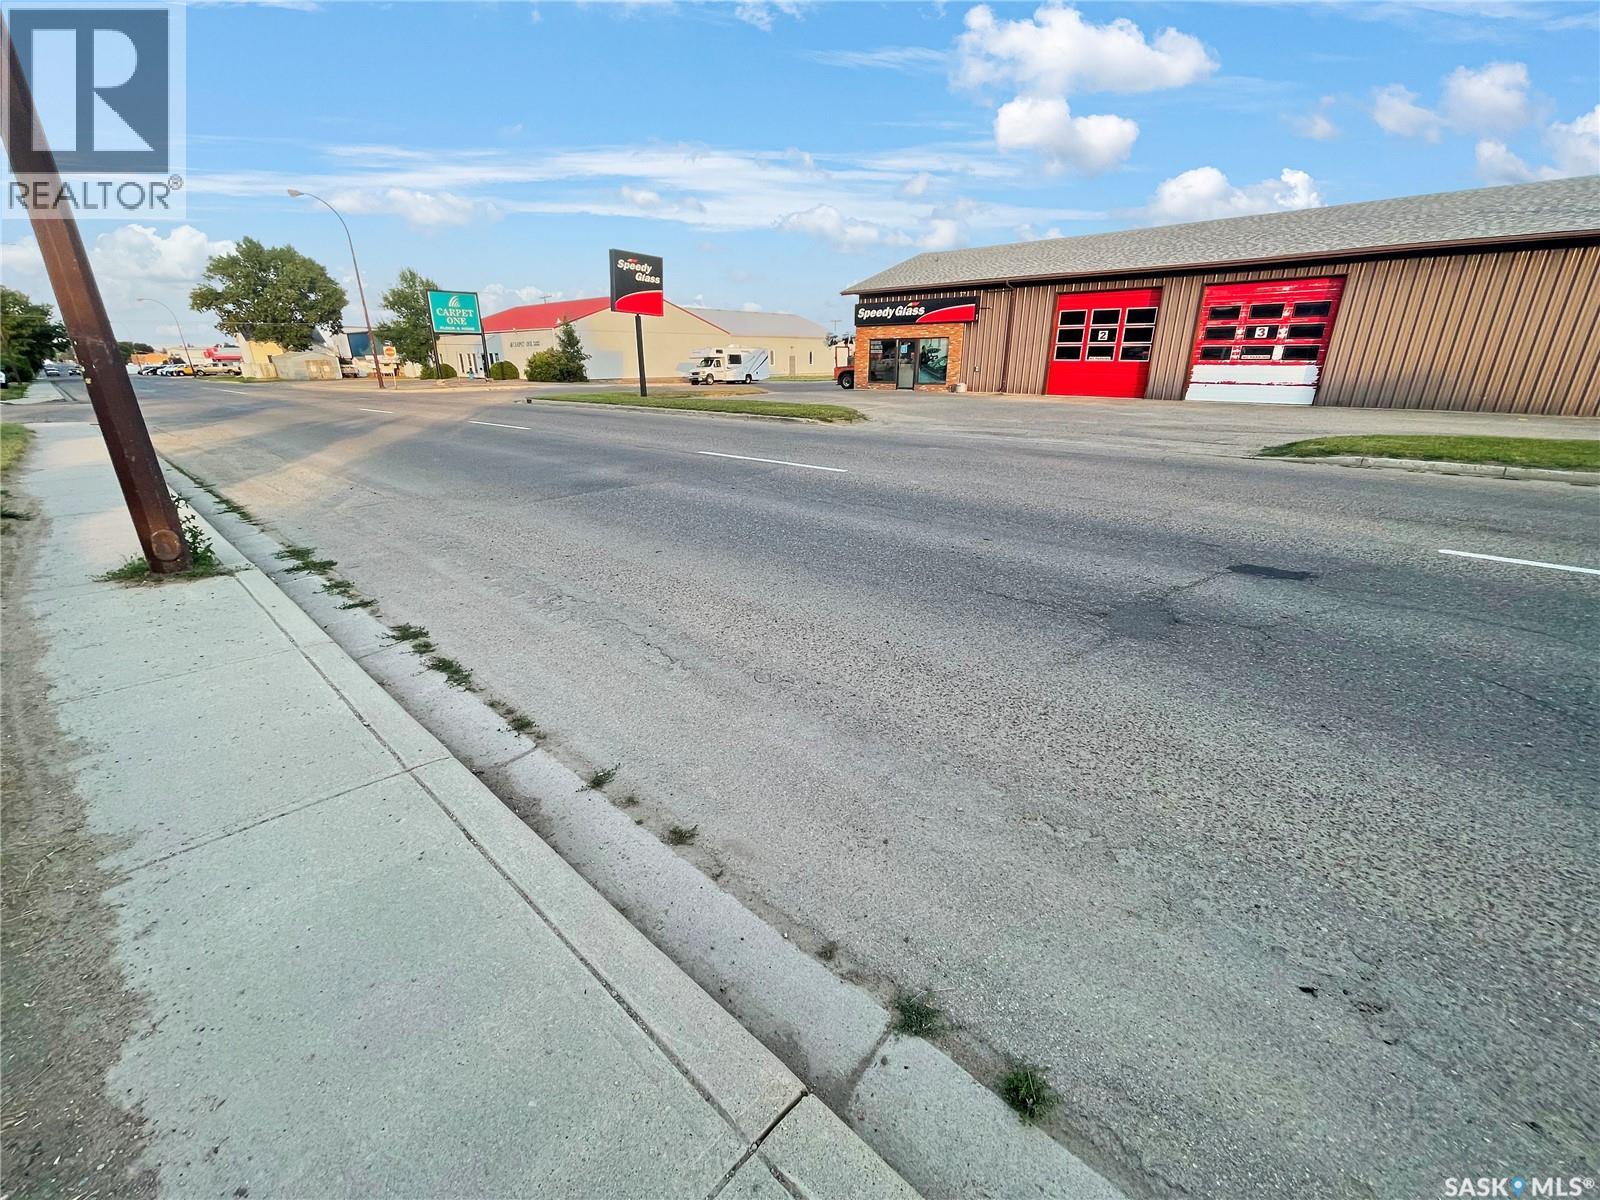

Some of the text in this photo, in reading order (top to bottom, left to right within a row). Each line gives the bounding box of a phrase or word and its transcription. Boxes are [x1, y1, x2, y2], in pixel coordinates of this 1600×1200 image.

[617, 259, 652, 274] Speedy
[635, 273, 660, 284] Glass
[436, 307, 474, 318] CARPET
[857, 305, 925, 319] Speedy Glass
[446, 316, 468, 325] ONE
[1099, 331, 1107, 339] 2
[1257, 328, 1266, 337] 3
